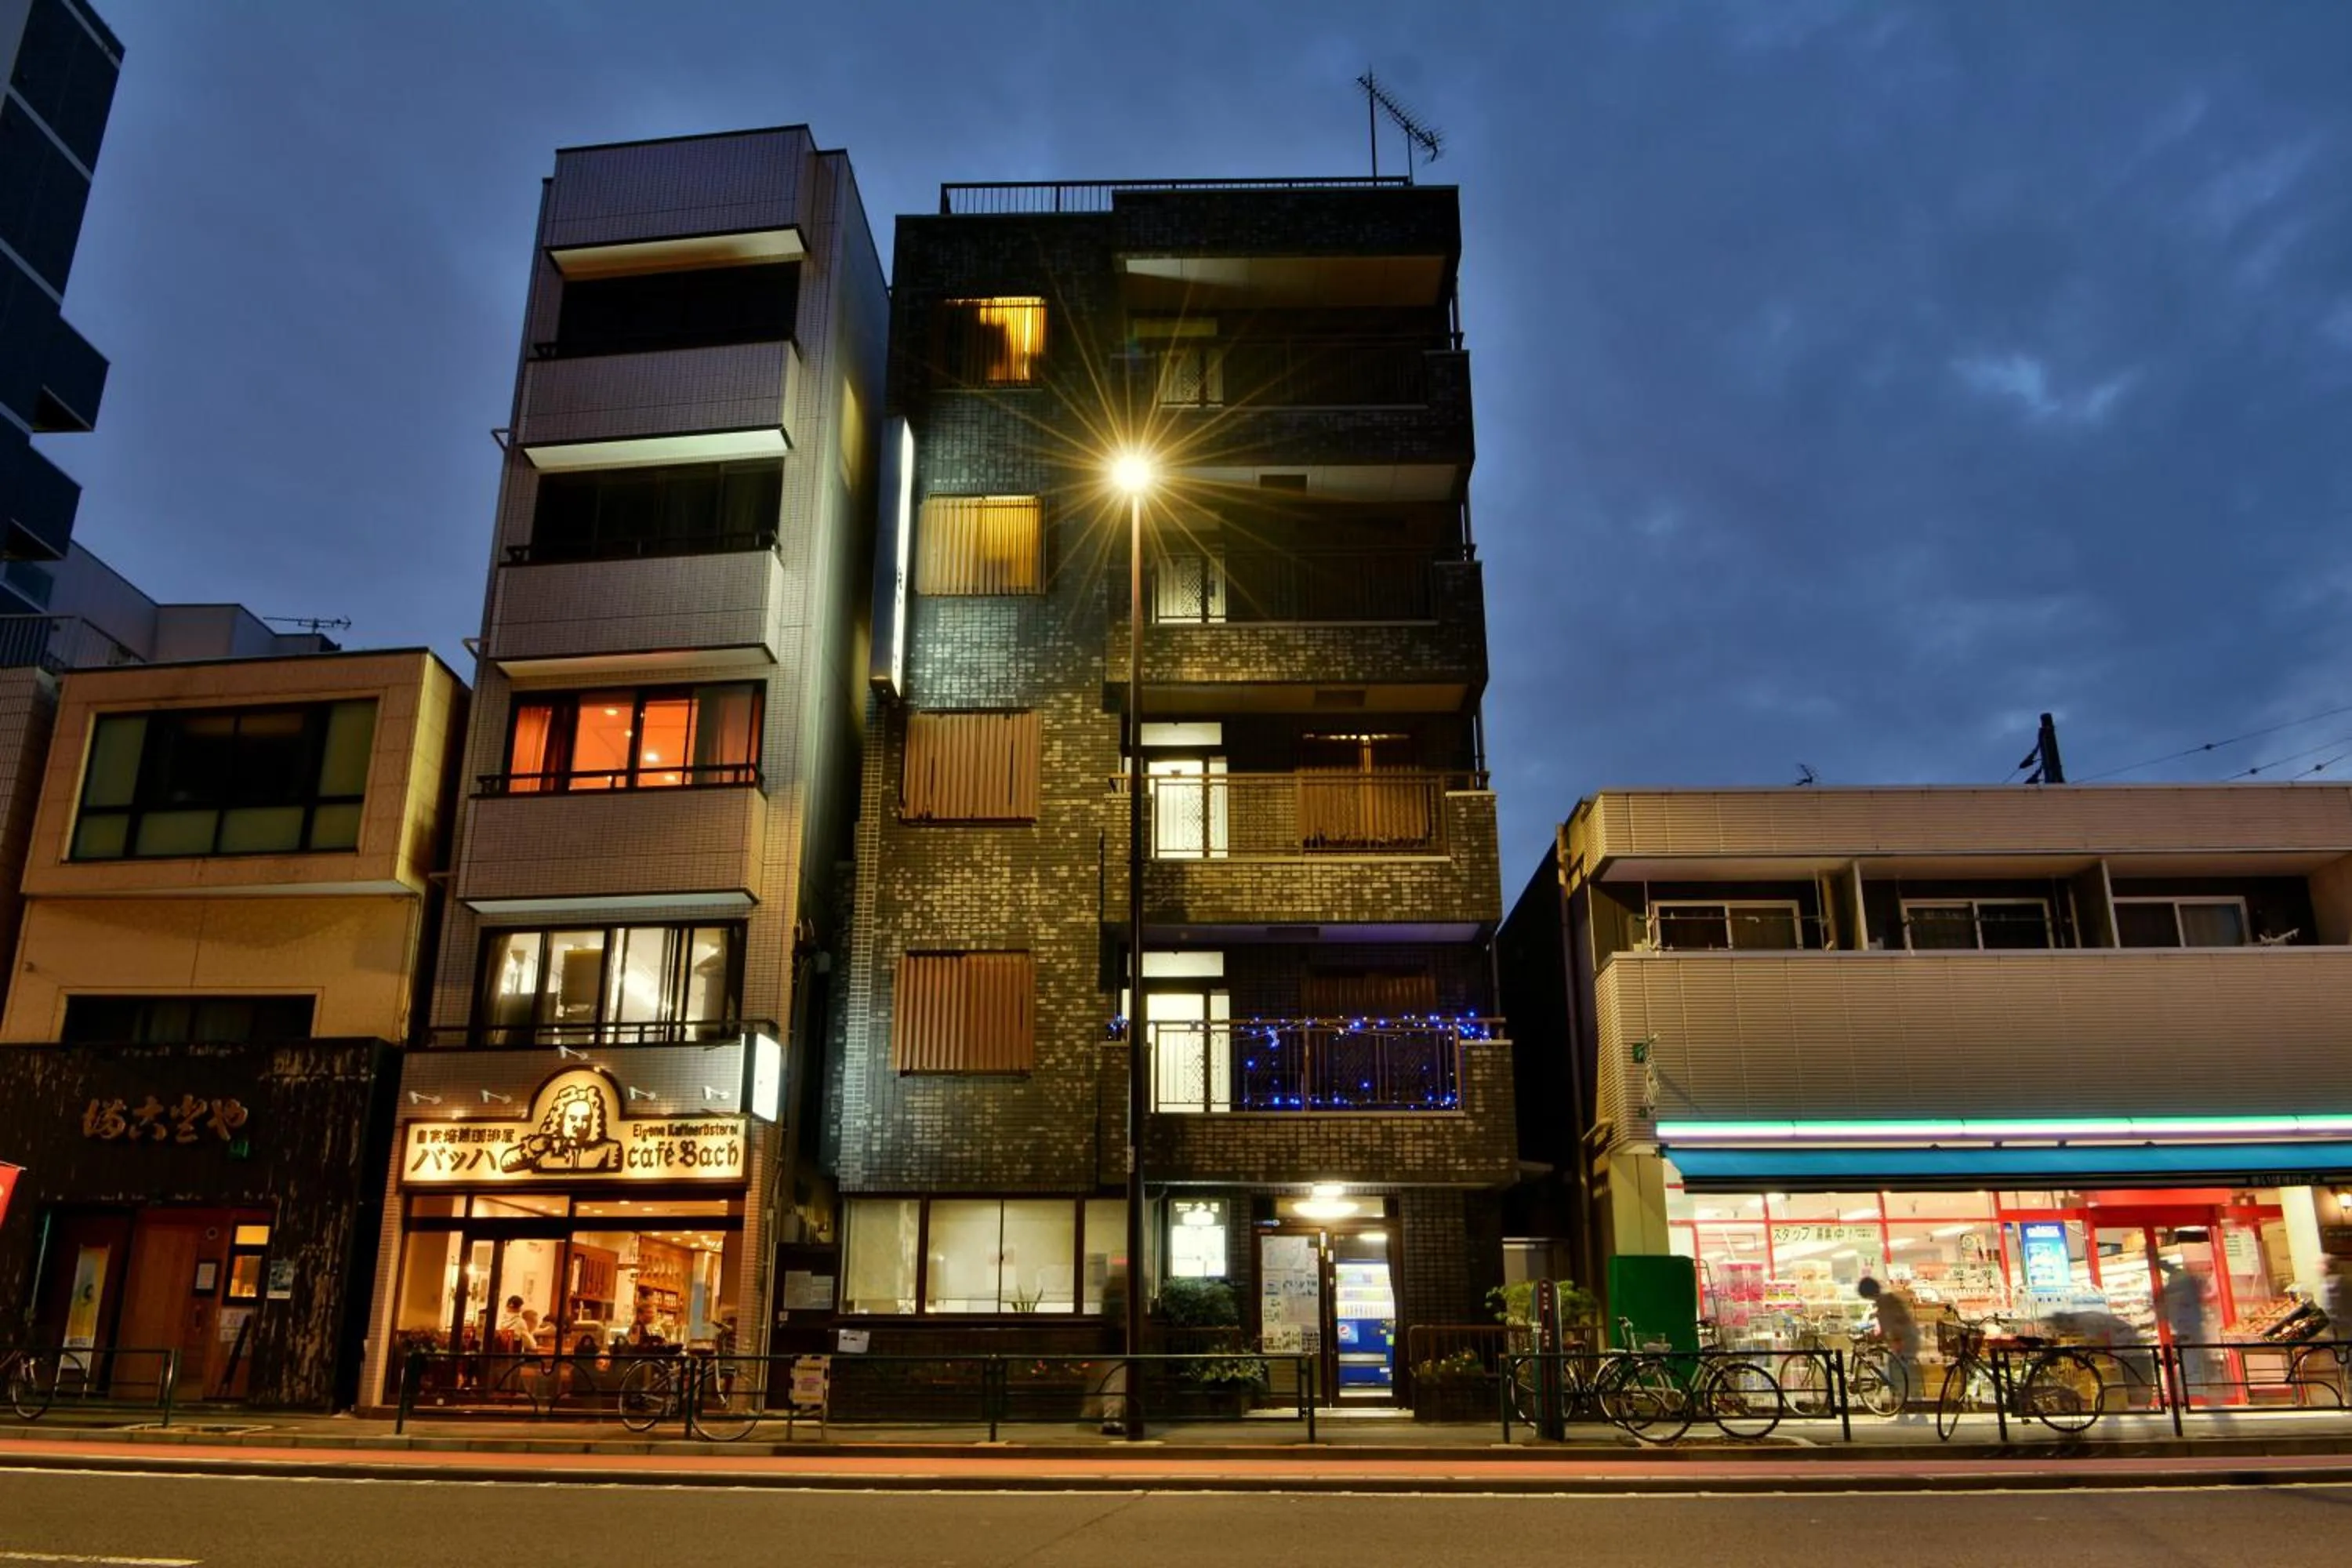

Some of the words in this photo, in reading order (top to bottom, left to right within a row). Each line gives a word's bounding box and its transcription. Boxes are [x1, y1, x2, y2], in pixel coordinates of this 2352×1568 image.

[410, 1147, 496, 1172] バッハ
[626, 1141, 674, 1168] café
[679, 1139, 739, 1168] Bach
